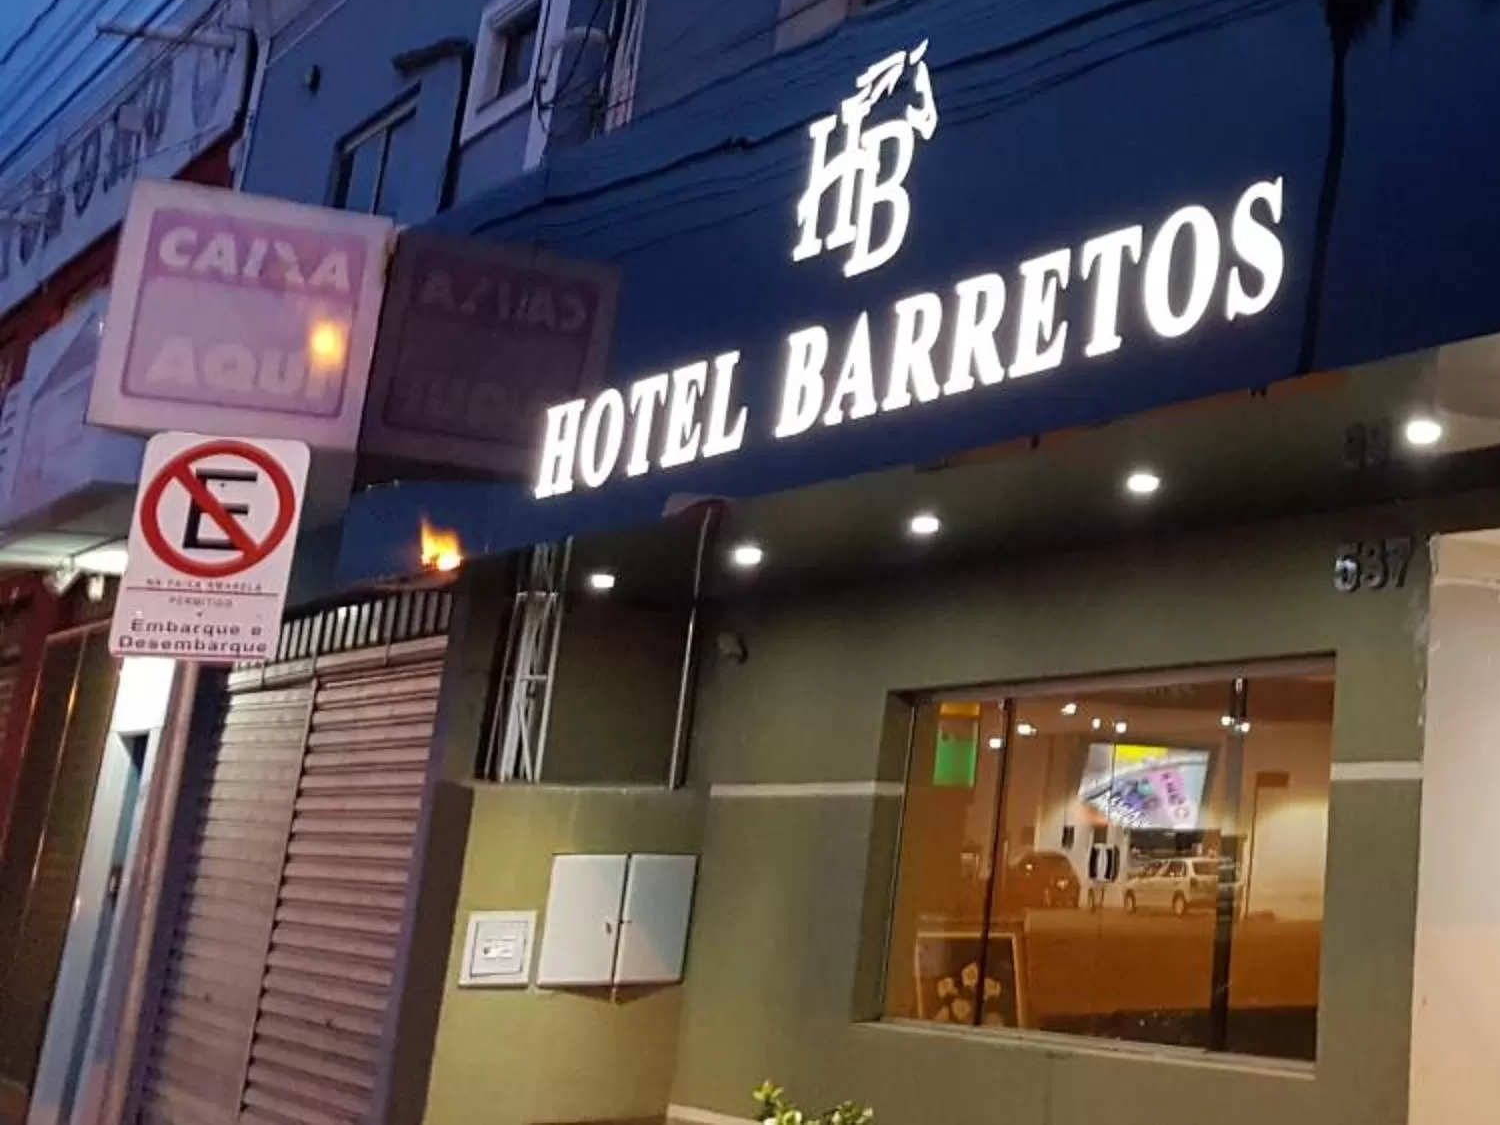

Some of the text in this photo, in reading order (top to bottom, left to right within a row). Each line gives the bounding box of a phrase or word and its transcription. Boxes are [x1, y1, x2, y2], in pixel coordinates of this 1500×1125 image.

[533, 176, 1287, 501] HOTEL BARRETOS
[130, 618, 262, 637] Embarque e
[118, 634, 268, 657] Desembarque
